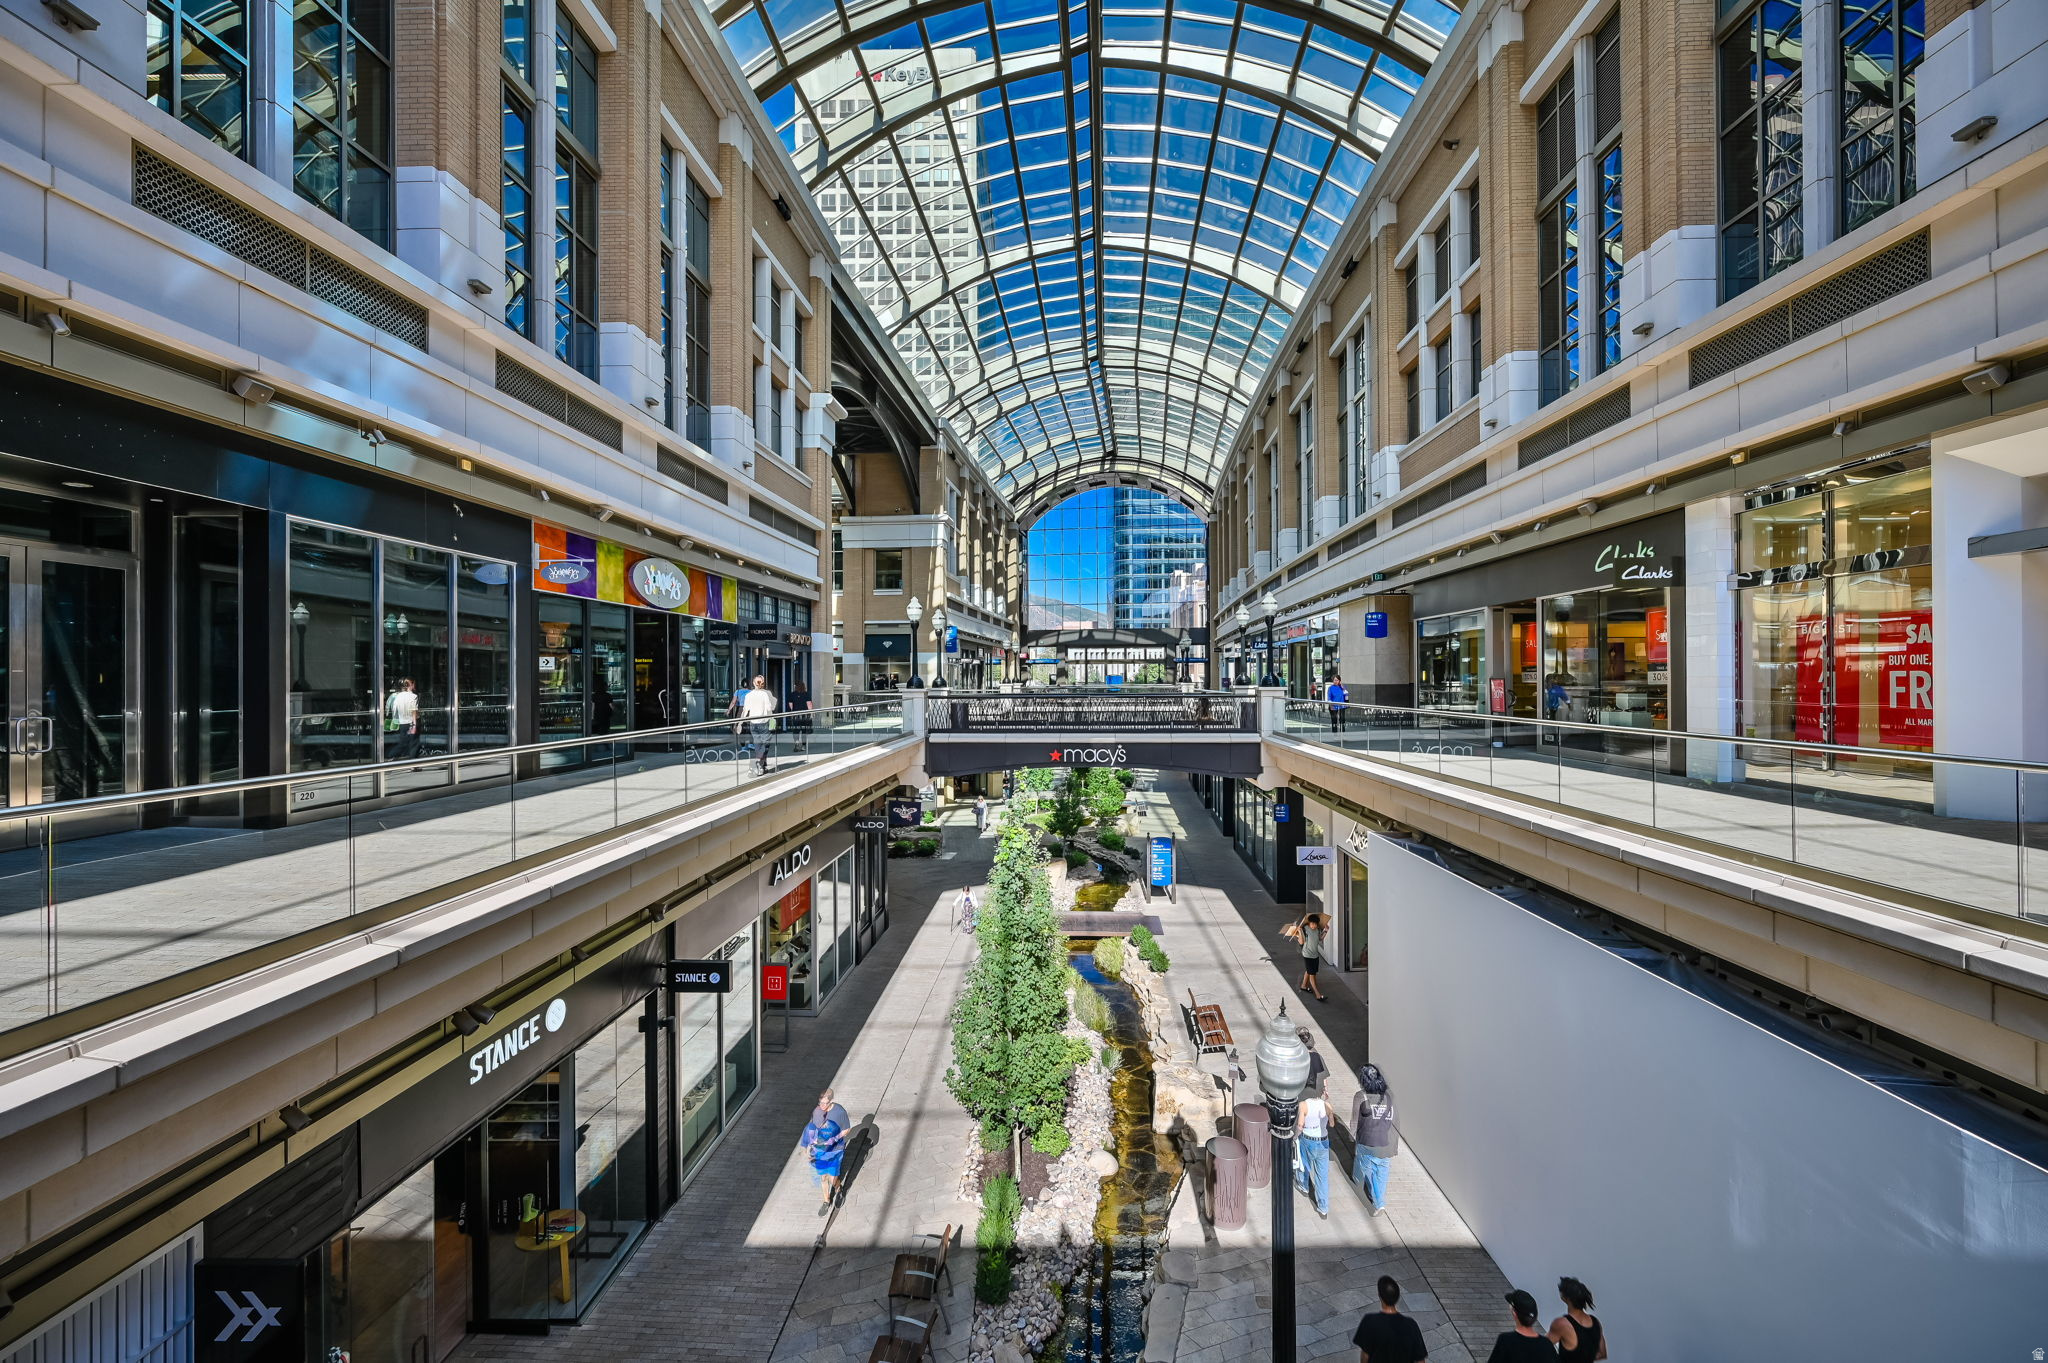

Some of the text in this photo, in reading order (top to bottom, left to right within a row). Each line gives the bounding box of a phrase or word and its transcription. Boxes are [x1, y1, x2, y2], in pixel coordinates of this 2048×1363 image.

[1621, 565, 1674, 580] Clarks
[1802, 624, 1854, 634] BIGST
[1888, 654, 1932, 667] BUY ONE,
[1888, 670, 1933, 709] FR
[1904, 717, 1917, 726] ALL
[1064, 744, 1127, 766] macy's
[300, 791, 315, 801] 220
[855, 821, 885, 829] ALDO
[773, 845, 811, 886] ALDO
[675, 973, 707, 983] STANCE
[469, 1014, 541, 1086] STANCE
